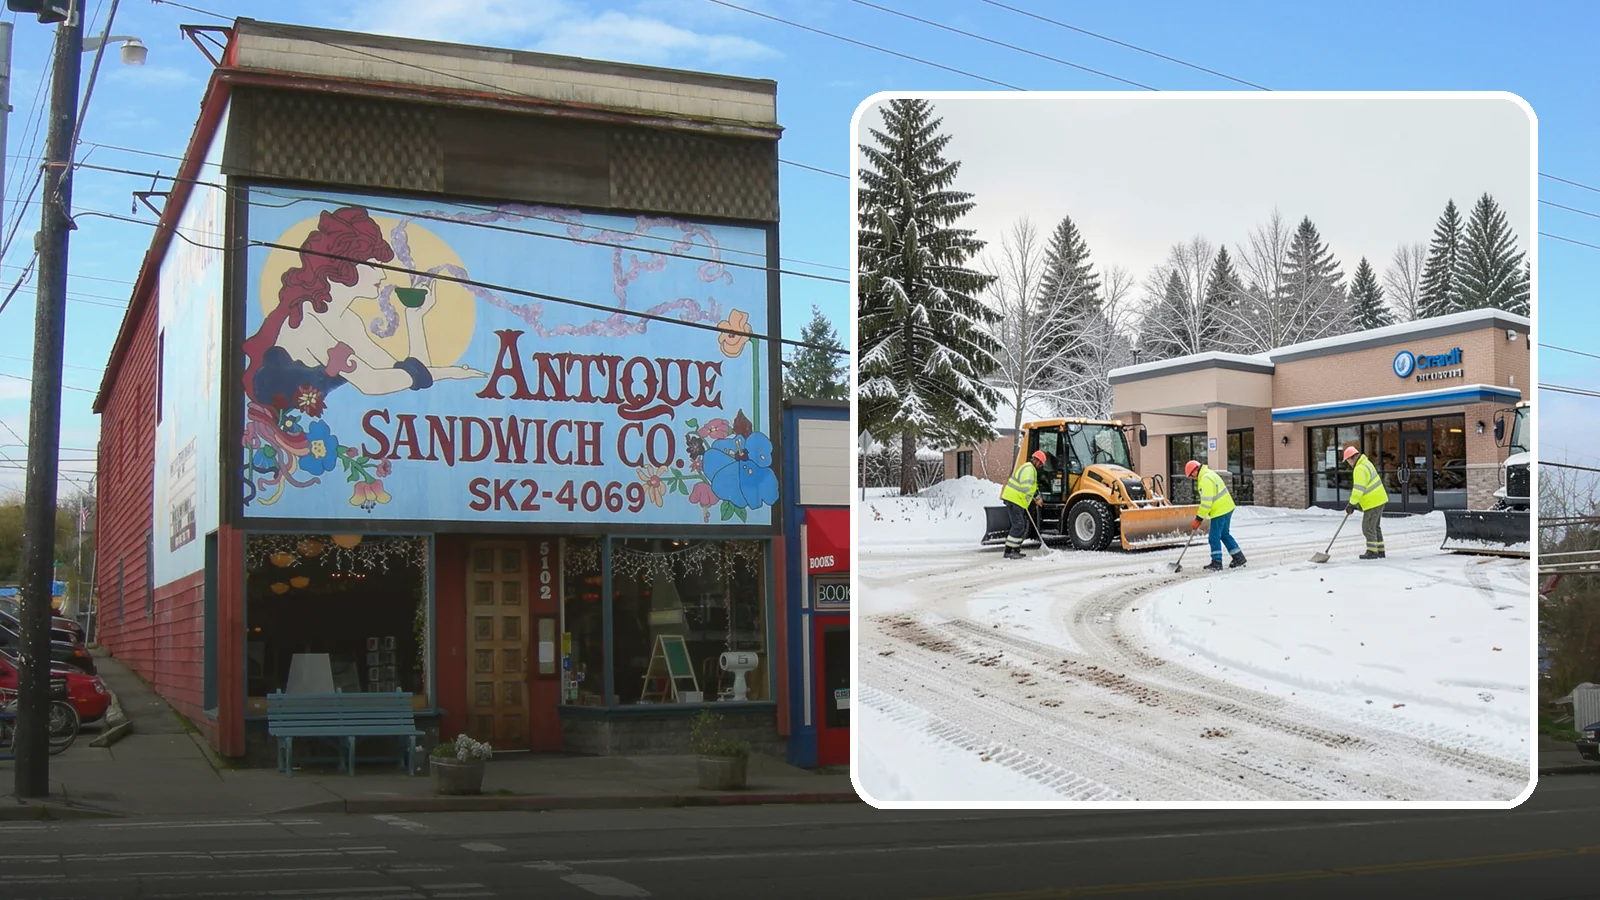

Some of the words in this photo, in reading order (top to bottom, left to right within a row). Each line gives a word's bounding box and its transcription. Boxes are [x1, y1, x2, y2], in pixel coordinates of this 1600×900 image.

[476, 329, 723, 420] ANTIQUE
[361, 408, 604, 467] SANDWICH
[617, 421, 685, 469] CO.
[468, 478, 646, 513] SK2-4069
[539, 541, 551, 600] 5102
[809, 555, 835, 569] BOOKS
